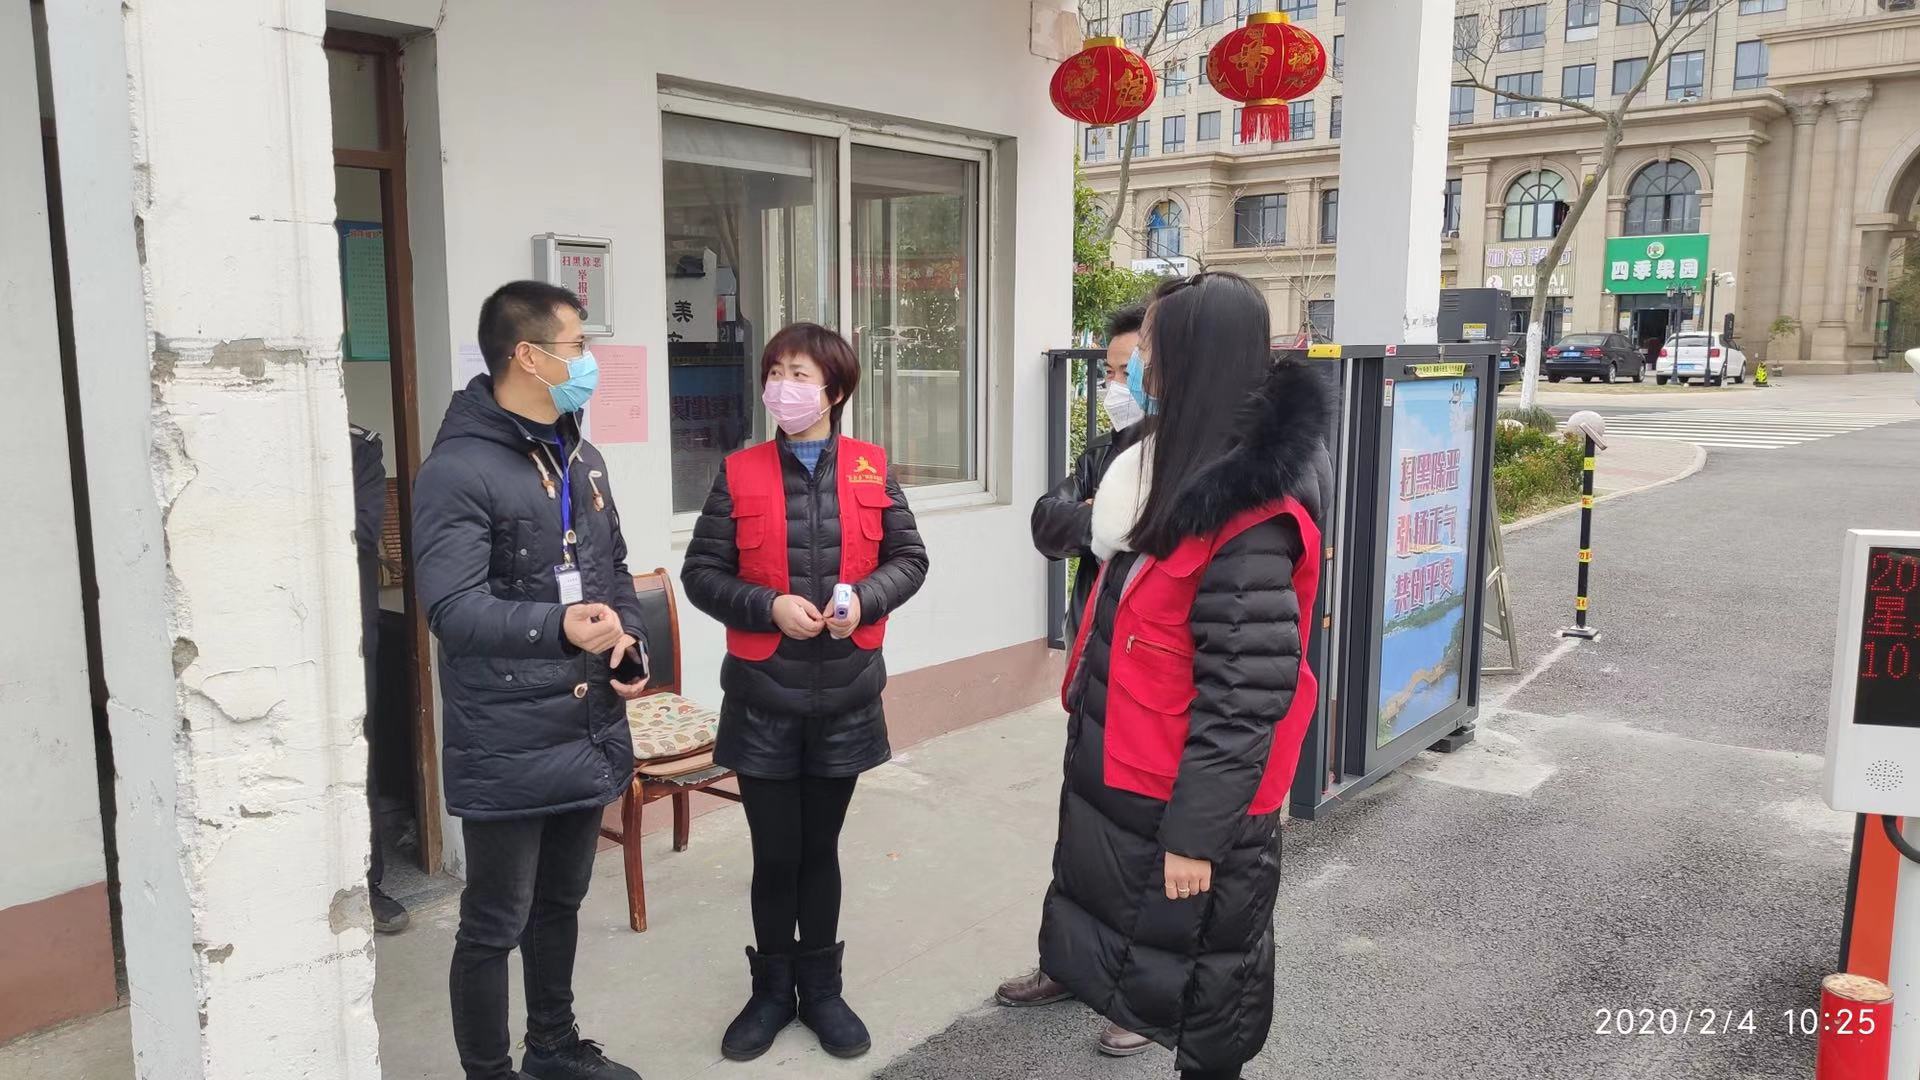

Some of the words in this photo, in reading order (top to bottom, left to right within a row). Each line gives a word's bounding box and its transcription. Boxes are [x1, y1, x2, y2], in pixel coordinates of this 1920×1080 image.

[562, 255, 602, 268] 扫黑除恶
[1611, 258, 1698, 281] 四季果园
[1512, 274, 1565, 287] RUAI
[1400, 449, 1460, 501] 扫黑除恶
[1396, 504, 1458, 559] 弘扬正气
[1866, 595, 1920, 639] 星
